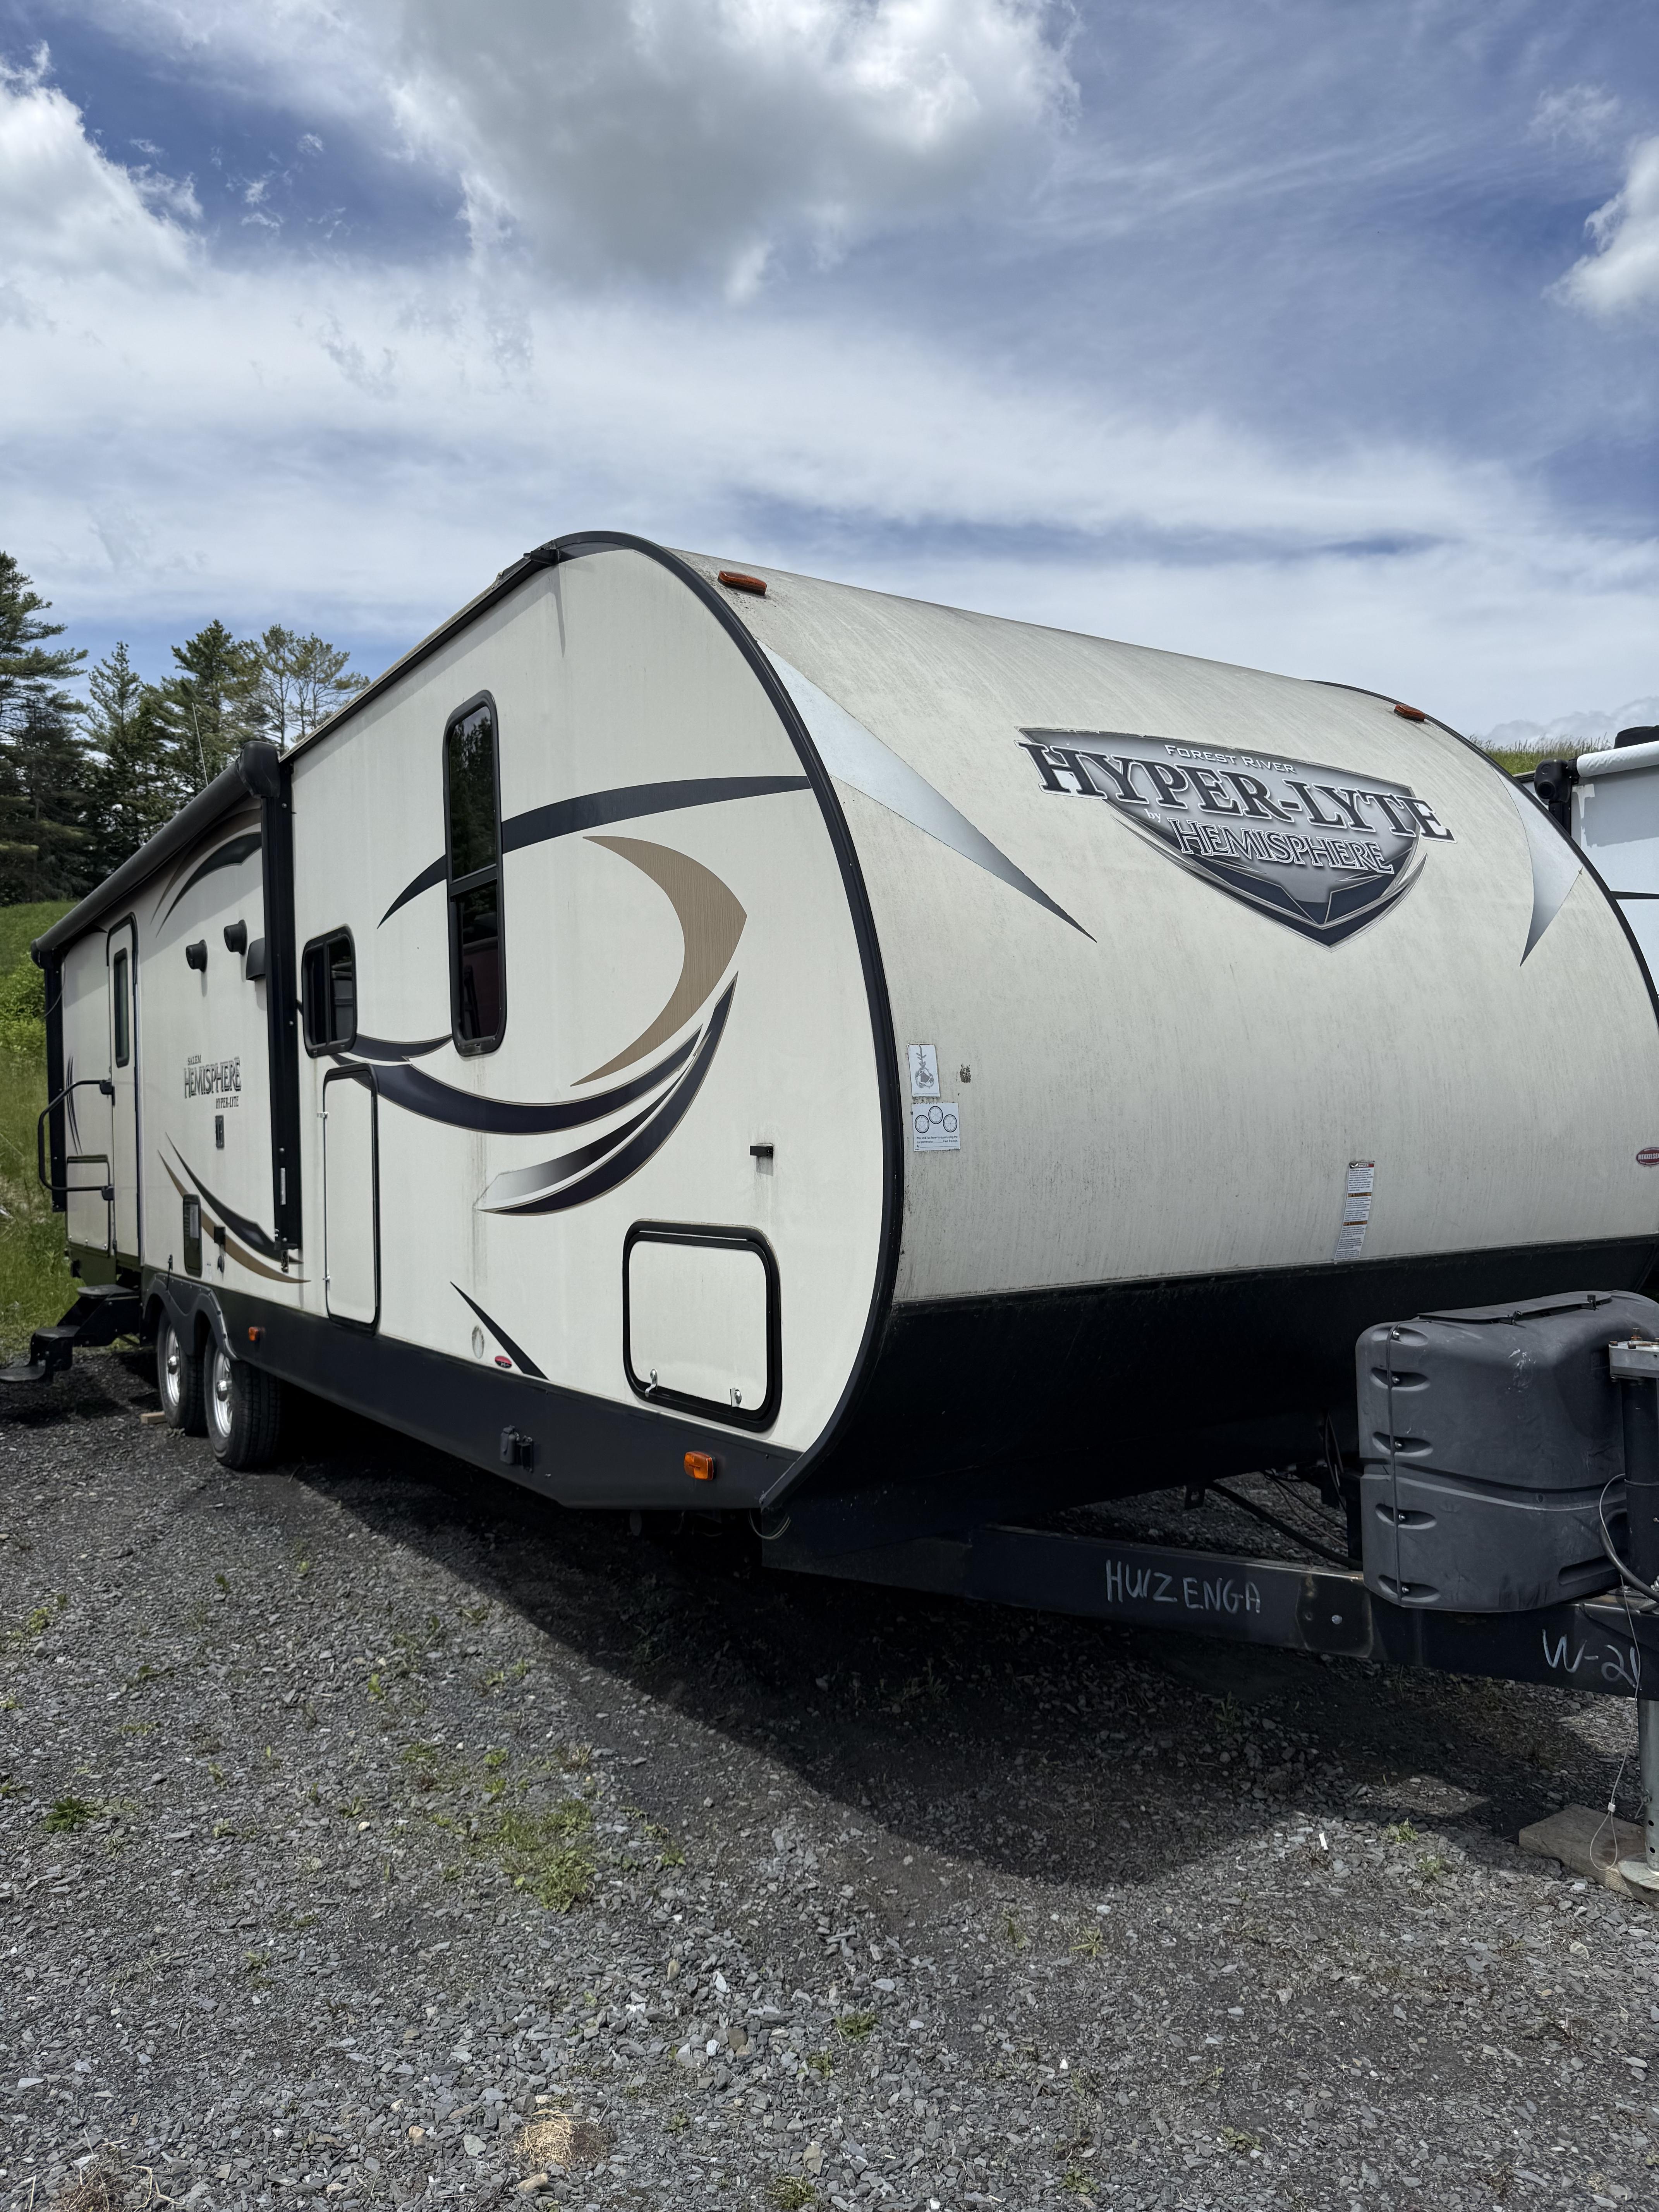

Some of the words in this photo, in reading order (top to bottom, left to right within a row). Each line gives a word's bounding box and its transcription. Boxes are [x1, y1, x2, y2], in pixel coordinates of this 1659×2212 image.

[1164, 745, 1236, 764] FOREST
[1241, 756, 1297, 774] RIVER
[1014, 740, 1458, 843] HYPER-LYTE
[1144, 809, 1161, 823] by
[1167, 817, 1395, 874] HEMISPHERE
[187, 1054, 201, 1065] SALEM
[184, 1056, 241, 1099] HEMISPHERE
[216, 1096, 239, 1109] HYPER-LYTE
